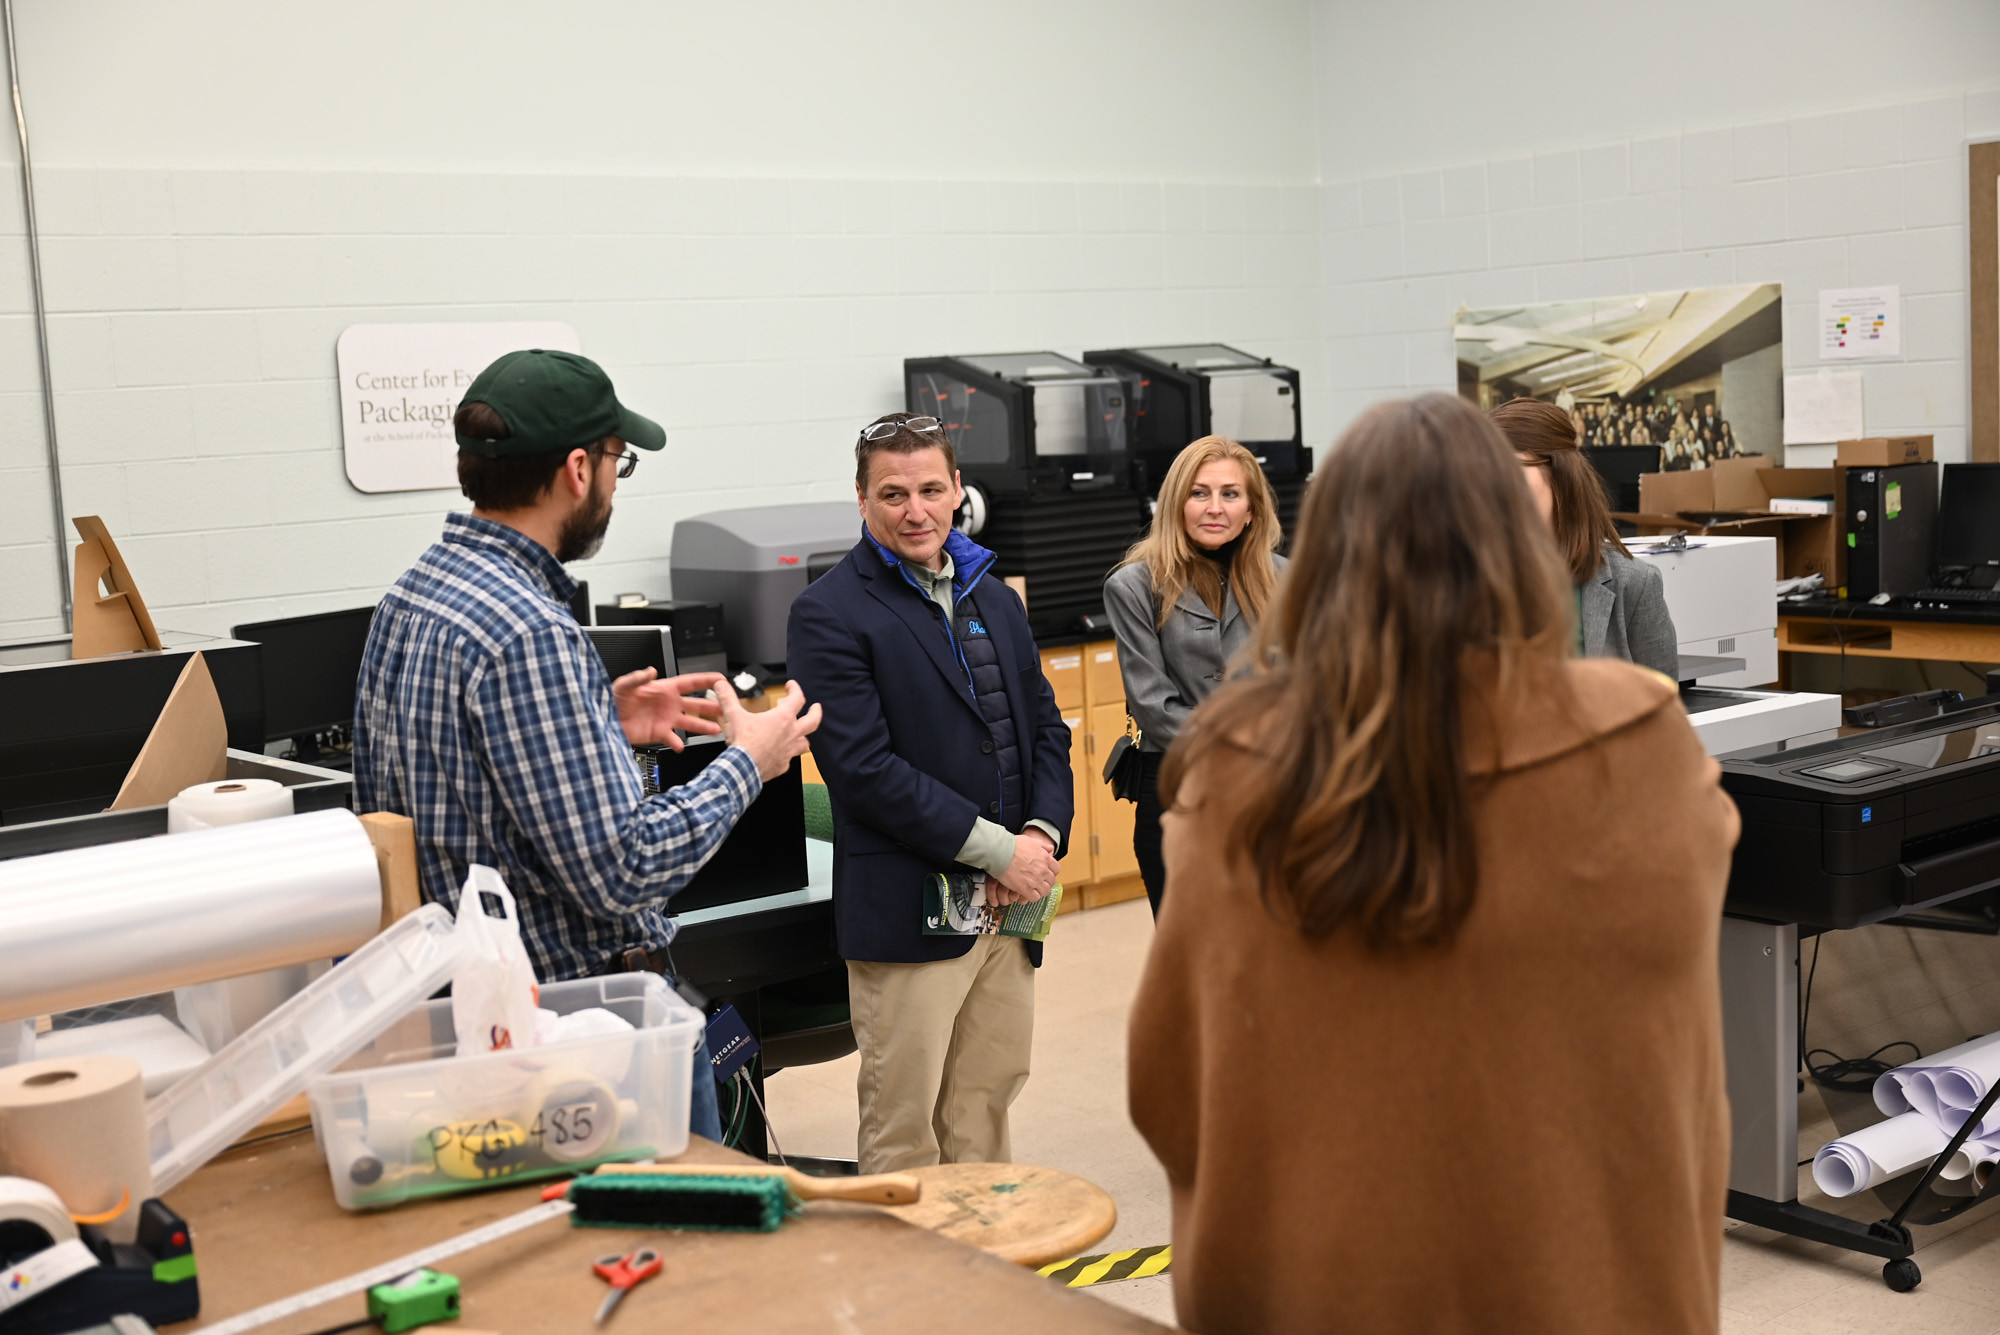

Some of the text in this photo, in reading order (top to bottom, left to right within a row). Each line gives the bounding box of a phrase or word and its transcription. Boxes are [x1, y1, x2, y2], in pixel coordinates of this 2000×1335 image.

[355, 368, 475, 390] Center for Ex
[359, 397, 457, 428] Packagi
[425, 430, 455, 441] Packag
[711, 1036, 740, 1065] NETGEAR
[530, 1106, 593, 1148] 485
